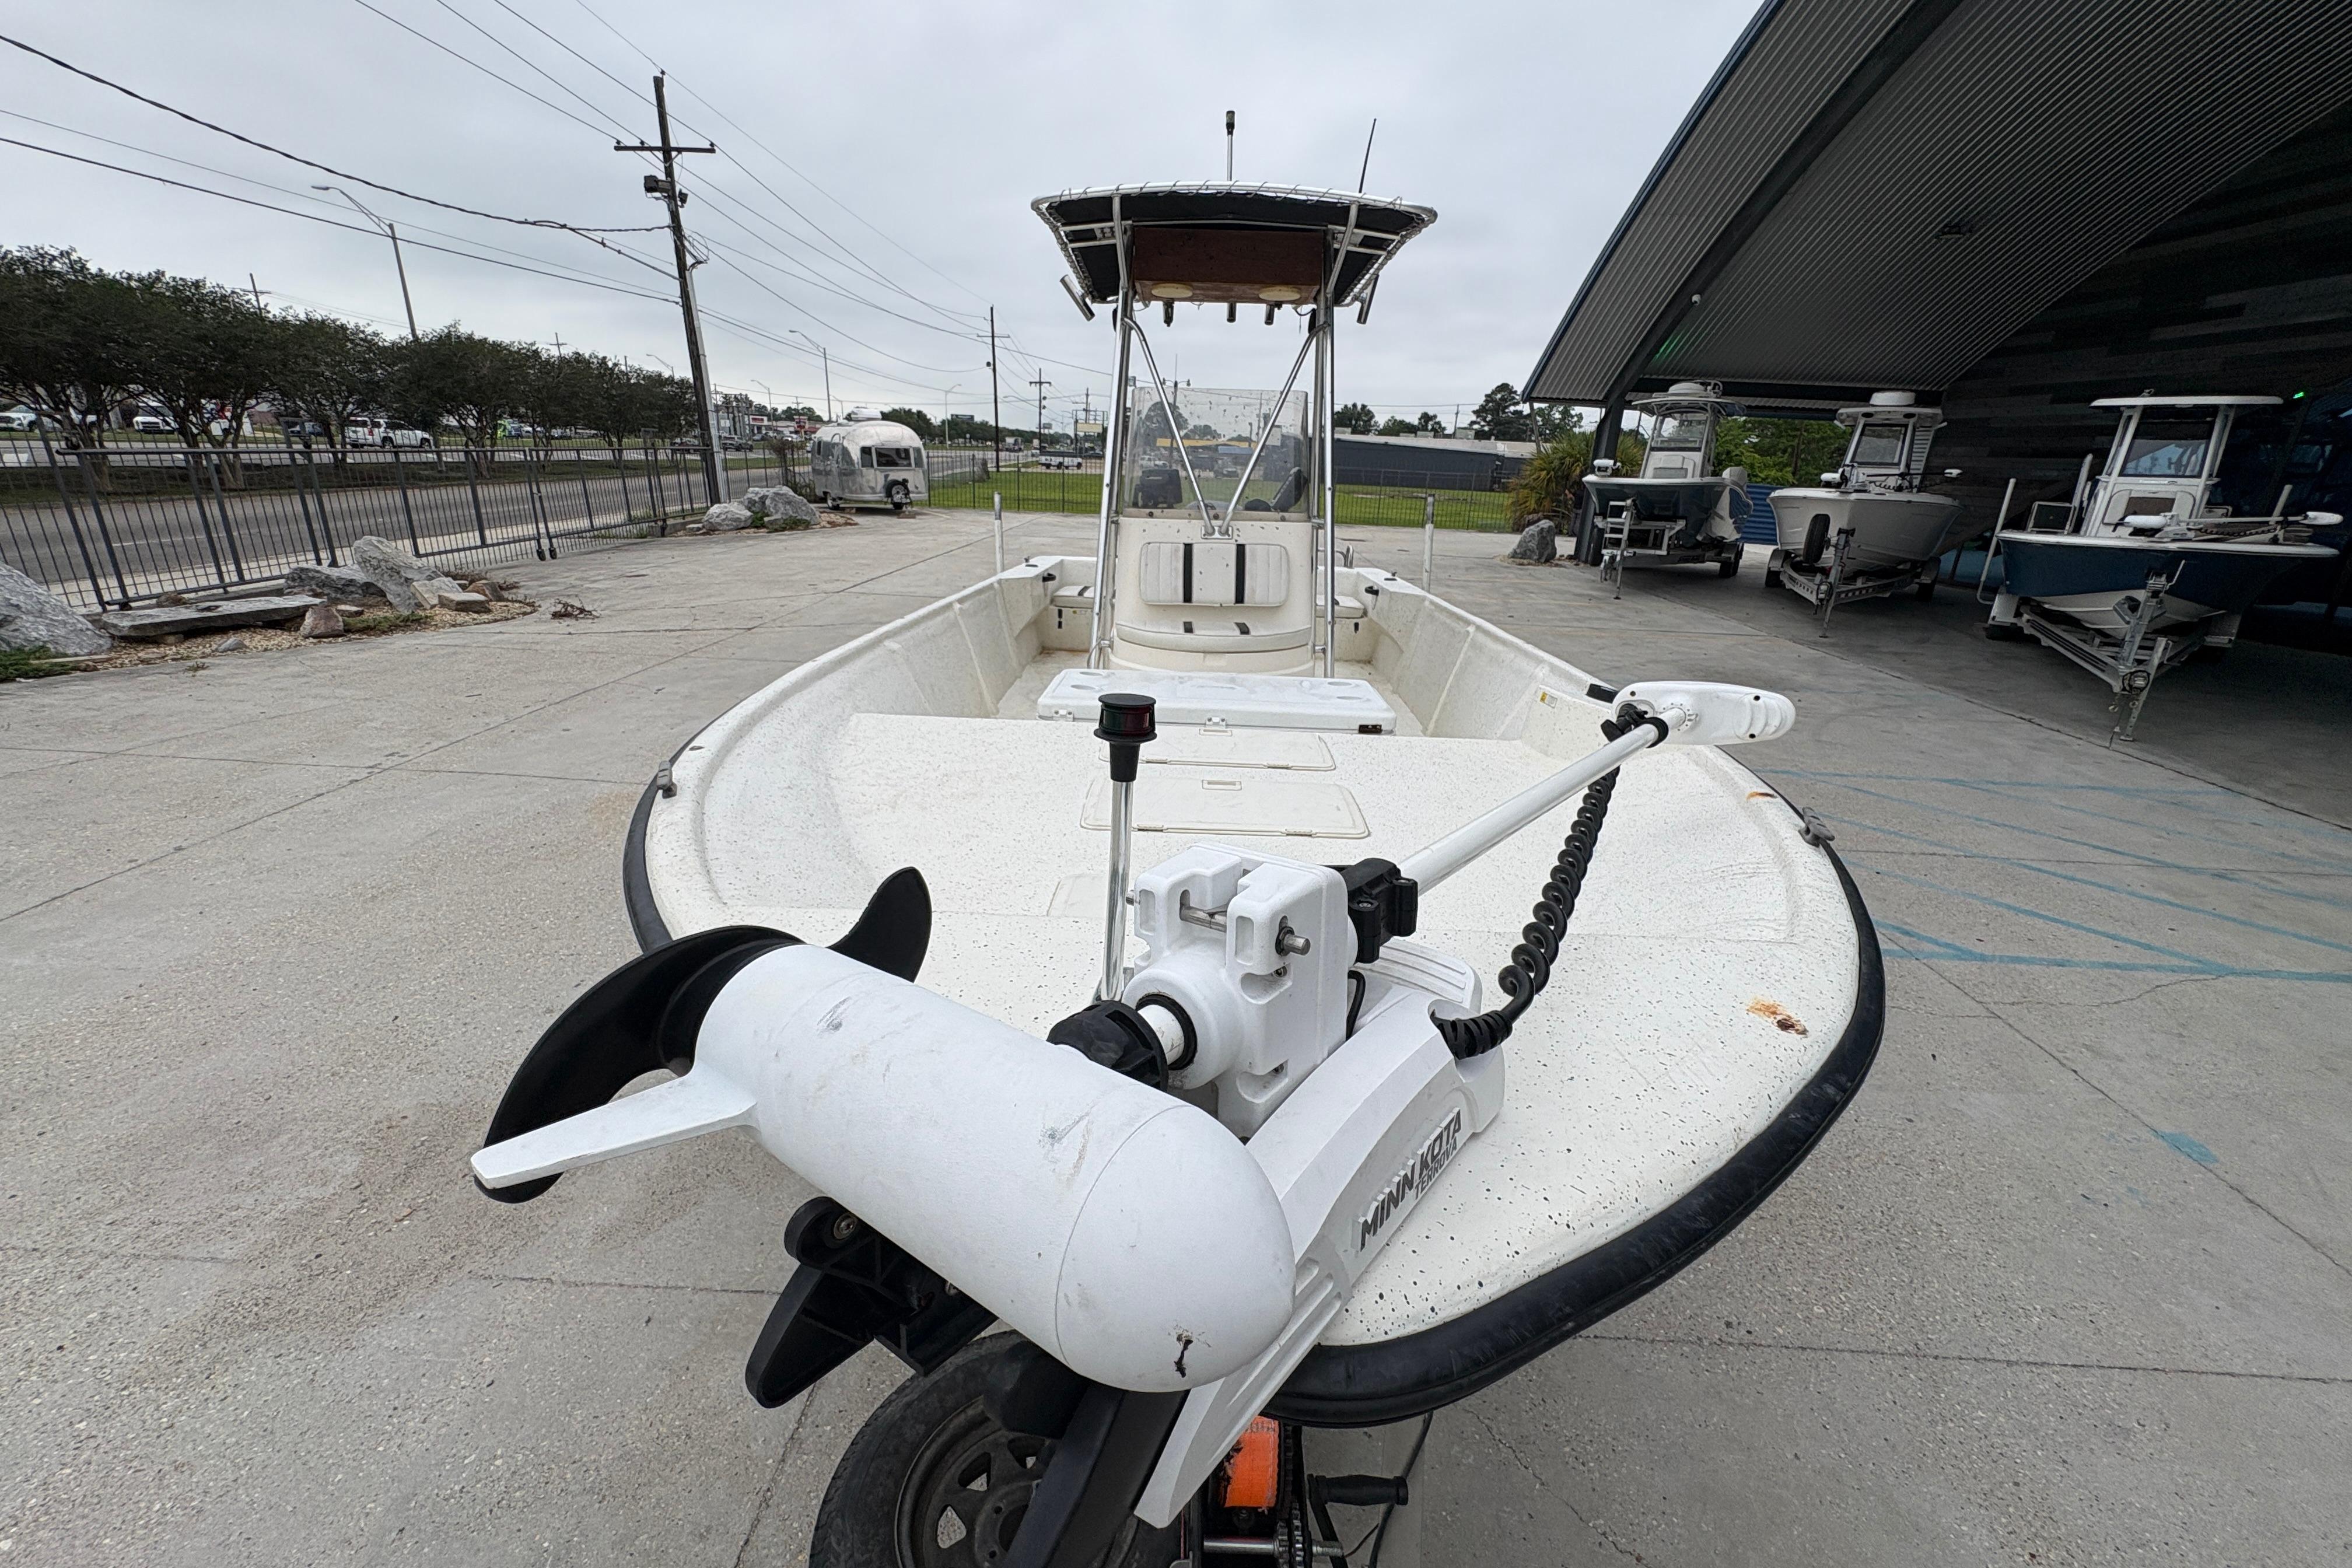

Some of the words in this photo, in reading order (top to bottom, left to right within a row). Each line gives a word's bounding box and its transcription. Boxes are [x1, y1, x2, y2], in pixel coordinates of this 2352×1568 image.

[1359, 1161, 1416, 1252] MINN
[1418, 1108, 1461, 1180] KOTA
[1415, 1136, 1458, 1200] TERROVA
